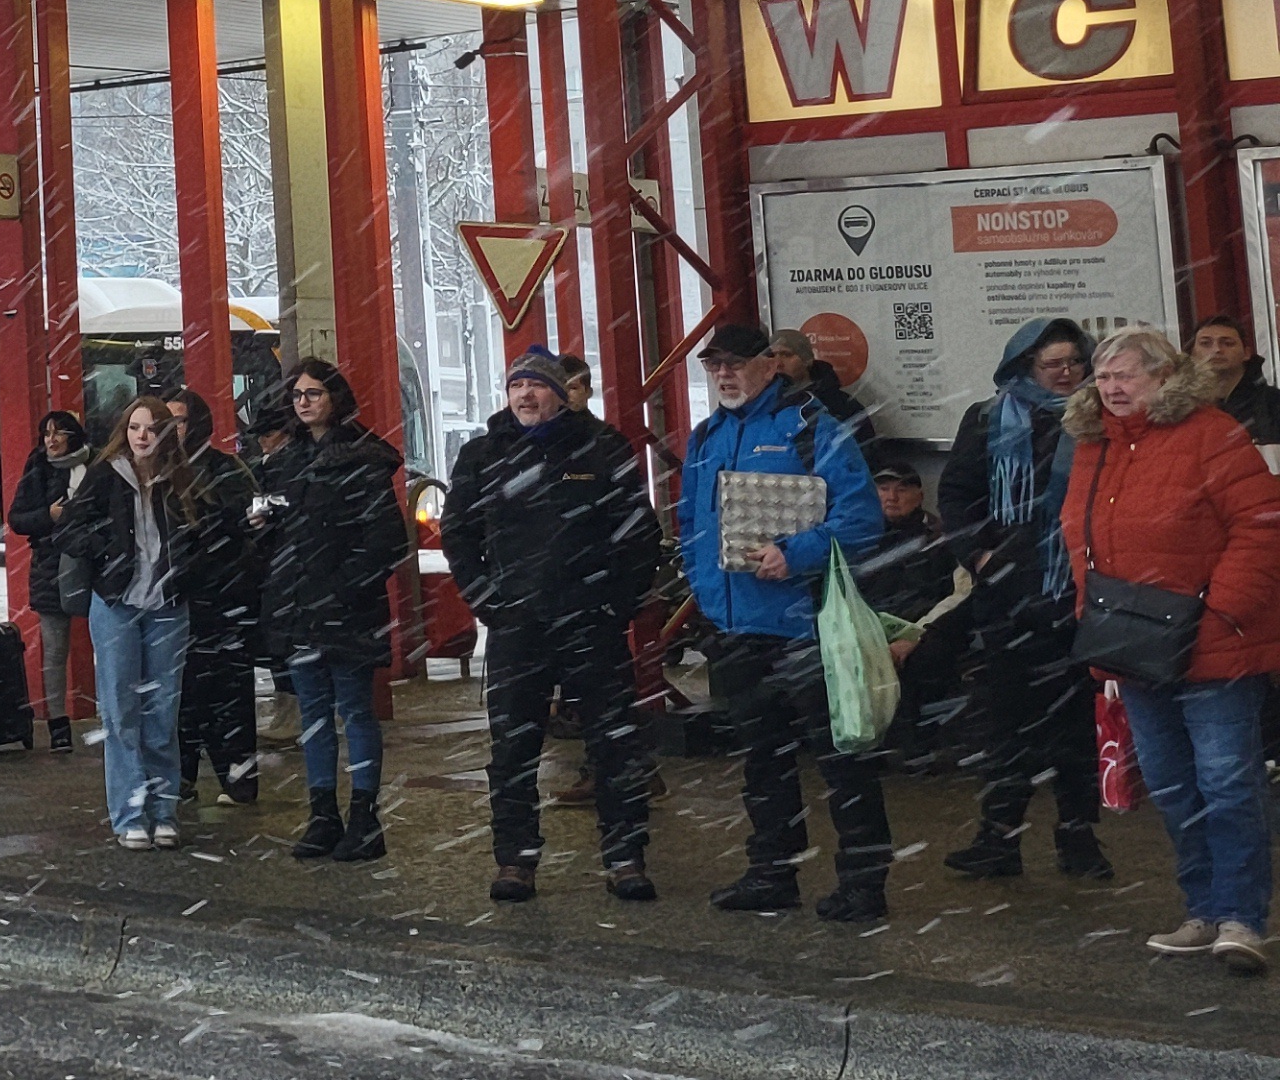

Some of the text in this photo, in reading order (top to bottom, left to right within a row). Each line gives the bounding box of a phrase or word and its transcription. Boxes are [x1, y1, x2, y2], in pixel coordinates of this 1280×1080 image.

[974, 187, 1011, 198] ČERPACÍ
[977, 209, 1069, 232] NONSTOP
[790, 264, 933, 282] ZDARMA DO GLOBUSU
[908, 282, 928, 291] ULICE
[163, 337, 185, 350] 55
